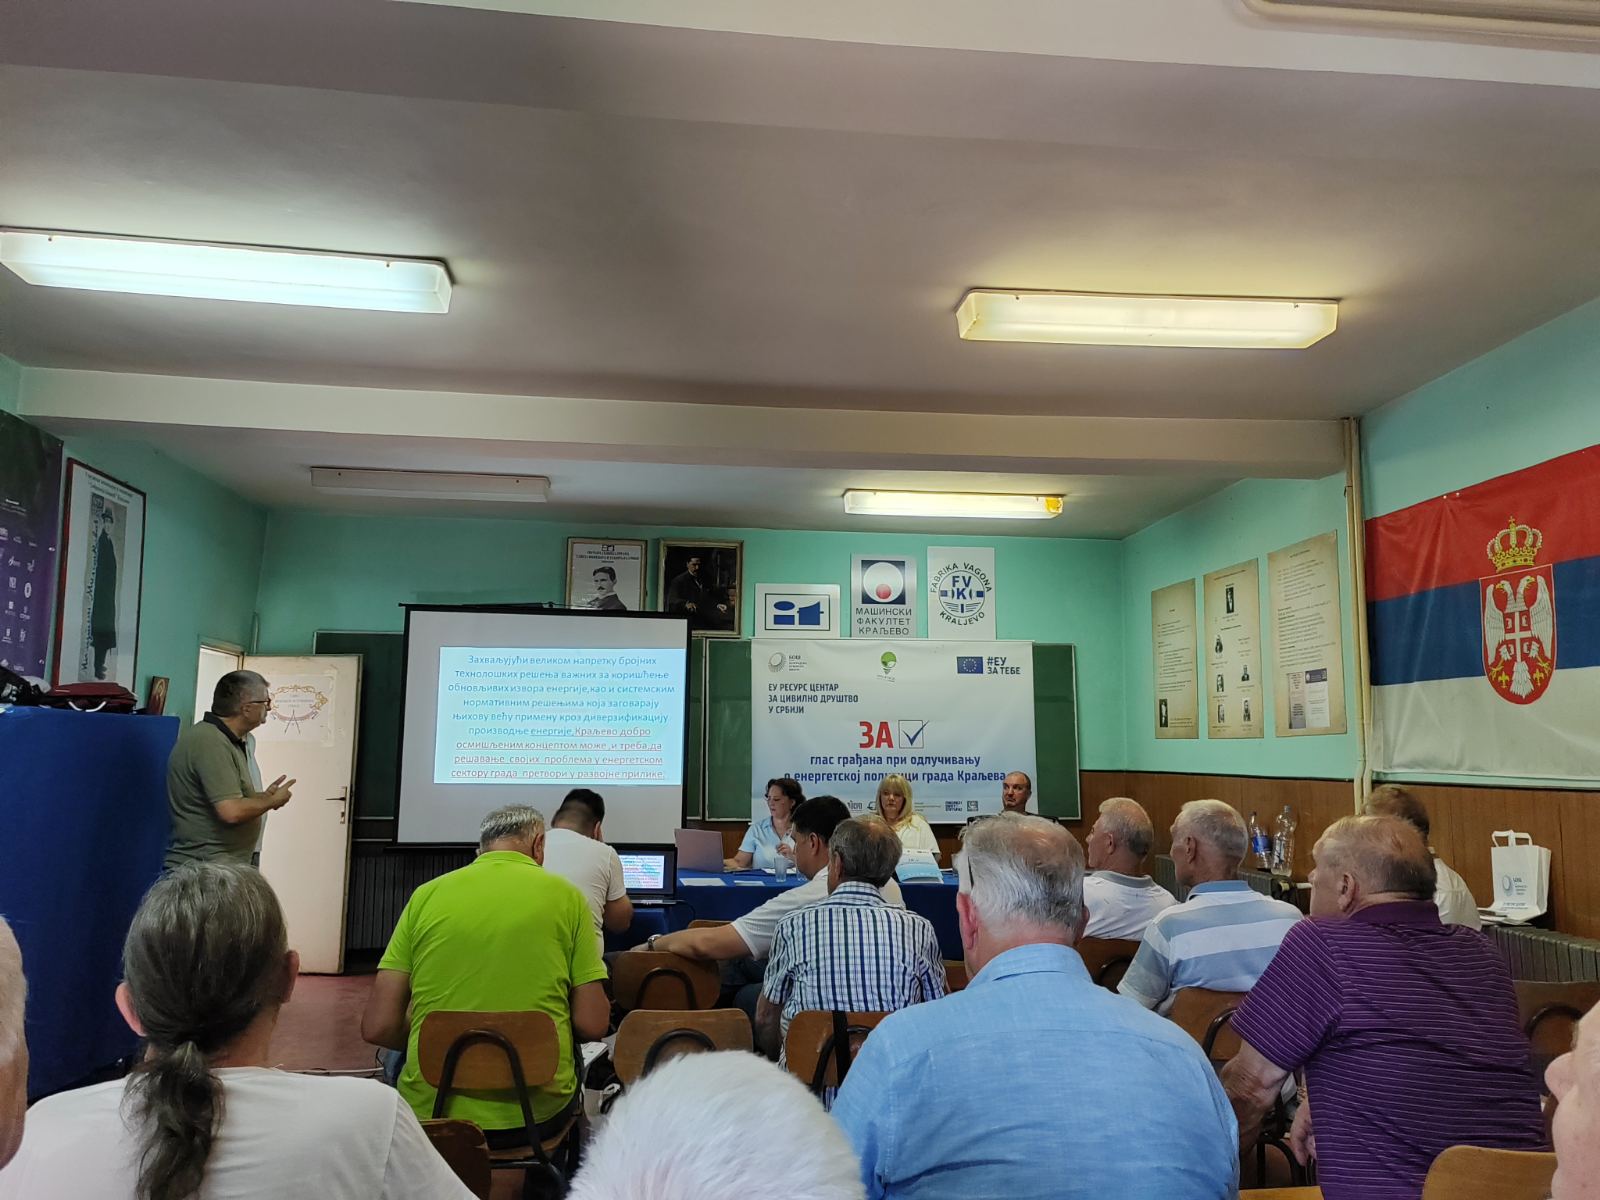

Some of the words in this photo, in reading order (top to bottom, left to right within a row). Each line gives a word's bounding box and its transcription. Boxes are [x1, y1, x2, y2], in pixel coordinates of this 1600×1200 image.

[930, 562, 959, 593] FABRIKA
[963, 562, 993, 593] VAGONA
[856, 608, 912, 616] МАШИНСКИ
[939, 610, 985, 626] KRALJEVO
[859, 628, 910, 636] КРАЉЕВО
[530, 657, 571, 665] великом
[573, 657, 616, 666] напретку
[618, 655, 656, 666] бројних
[987, 656, 1006, 666] #ЕУ
[987, 666, 998, 674] ЗА
[1000, 666, 1020, 674] ТЕБЕ
[598, 672, 609, 680] за
[448, 683, 509, 692] обновљивих
[510, 686, 544, 694] извора
[768, 684, 778, 692] ЕУ
[780, 684, 808, 692] РЕСУРС
[810, 684, 839, 692] ЦЕНТАР
[768, 694, 778, 702] ЗА
[780, 694, 818, 703] ЦИВИЛНО
[820, 694, 858, 703] ДРУШТВО
[768, 706, 773, 714] У
[776, 706, 804, 714] СРБИЈИ
[491, 712, 513, 722] већу
[515, 714, 558, 723] примену
[468, 727, 530, 736] производње
[620, 726, 651, 737] добро
[859, 721, 894, 749] ЗА
[544, 755, 592, 766] проблема
[810, 754, 834, 765] глас
[838, 754, 882, 768] грађана
[886, 755, 906, 768] при
[910, 755, 981, 768] одлучивању
[794, 770, 861, 784] енергетској
[922, 772, 954, 784] града
[958, 770, 1006, 782] Краљева
